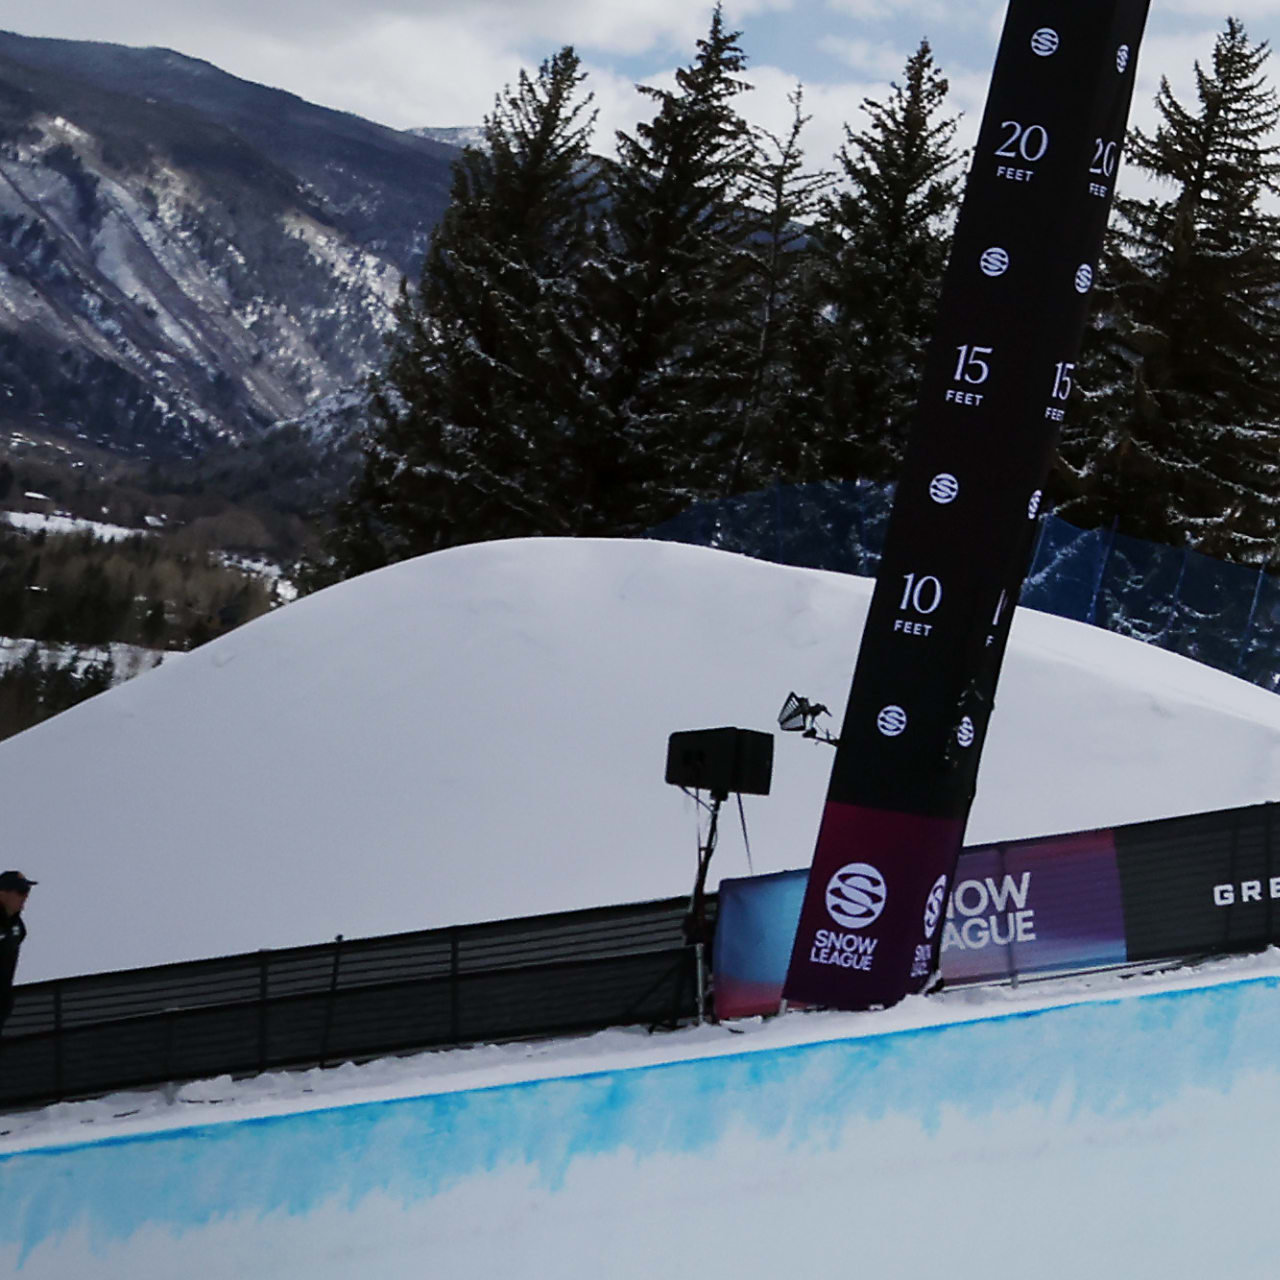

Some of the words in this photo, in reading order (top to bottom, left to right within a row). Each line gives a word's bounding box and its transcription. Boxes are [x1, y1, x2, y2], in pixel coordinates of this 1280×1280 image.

[994, 120, 1049, 162] 20
[1089, 138, 1117, 177] 20
[996, 165, 1034, 183] FEET
[953, 344, 993, 384] 15
[1052, 362, 1075, 400] 15
[945, 390, 984, 407] FEET
[900, 572, 942, 614] 10
[894, 620, 932, 637] FEET
[945, 872, 1031, 919] OW
[815, 929, 878, 954] SNOW
[941, 910, 1036, 952] AGUE
[809, 947, 874, 971] LEAGUE
